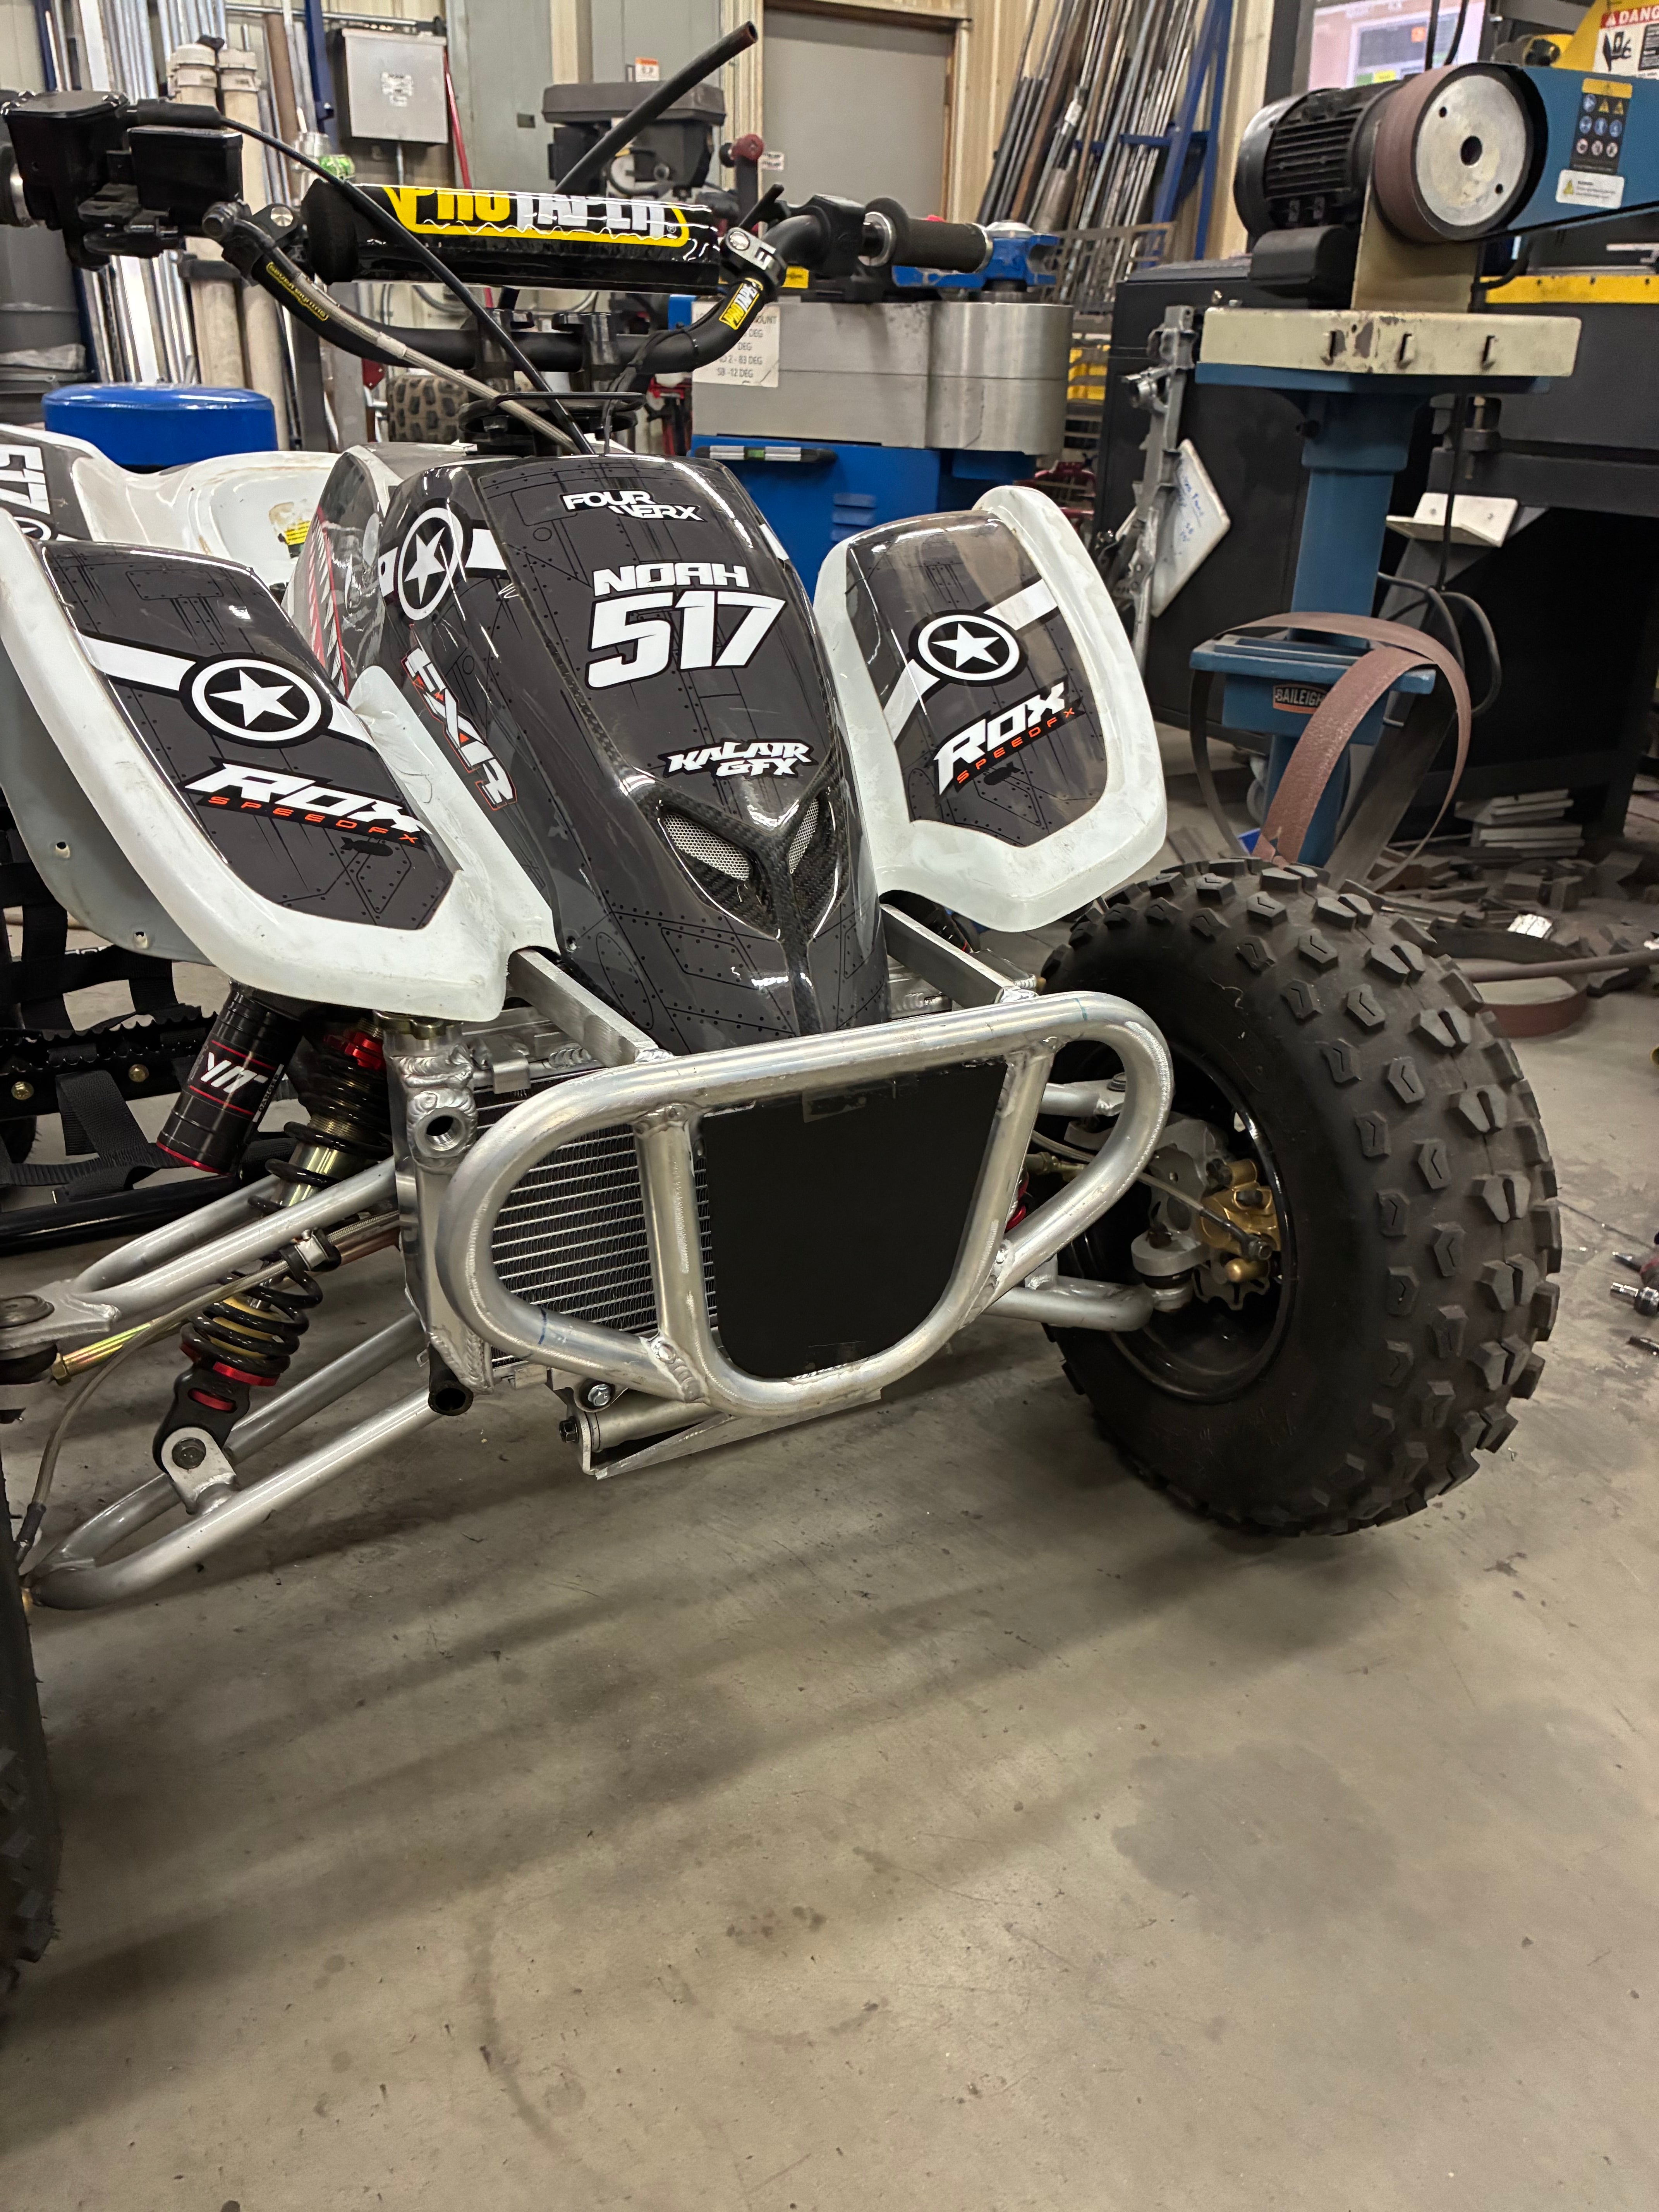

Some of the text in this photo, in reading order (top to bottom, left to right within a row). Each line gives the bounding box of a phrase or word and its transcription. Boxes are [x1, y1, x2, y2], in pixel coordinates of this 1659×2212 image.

[562, 491, 656, 510] FOUR
[608, 504, 705, 522] WERX
[592, 562, 750, 596] NOAH
[587, 590, 786, 688] 517
[1276, 687, 1326, 707] BAILEIGH
[405, 644, 514, 806] FXR
[933, 681, 1065, 795] ROX
[957, 707, 1075, 784] SPEEDFX
[667, 741, 809, 773] KALAIR
[716, 757, 798, 777] GFX
[184, 763, 433, 812] ROX
[207, 796, 419, 844] SPEEDFX
